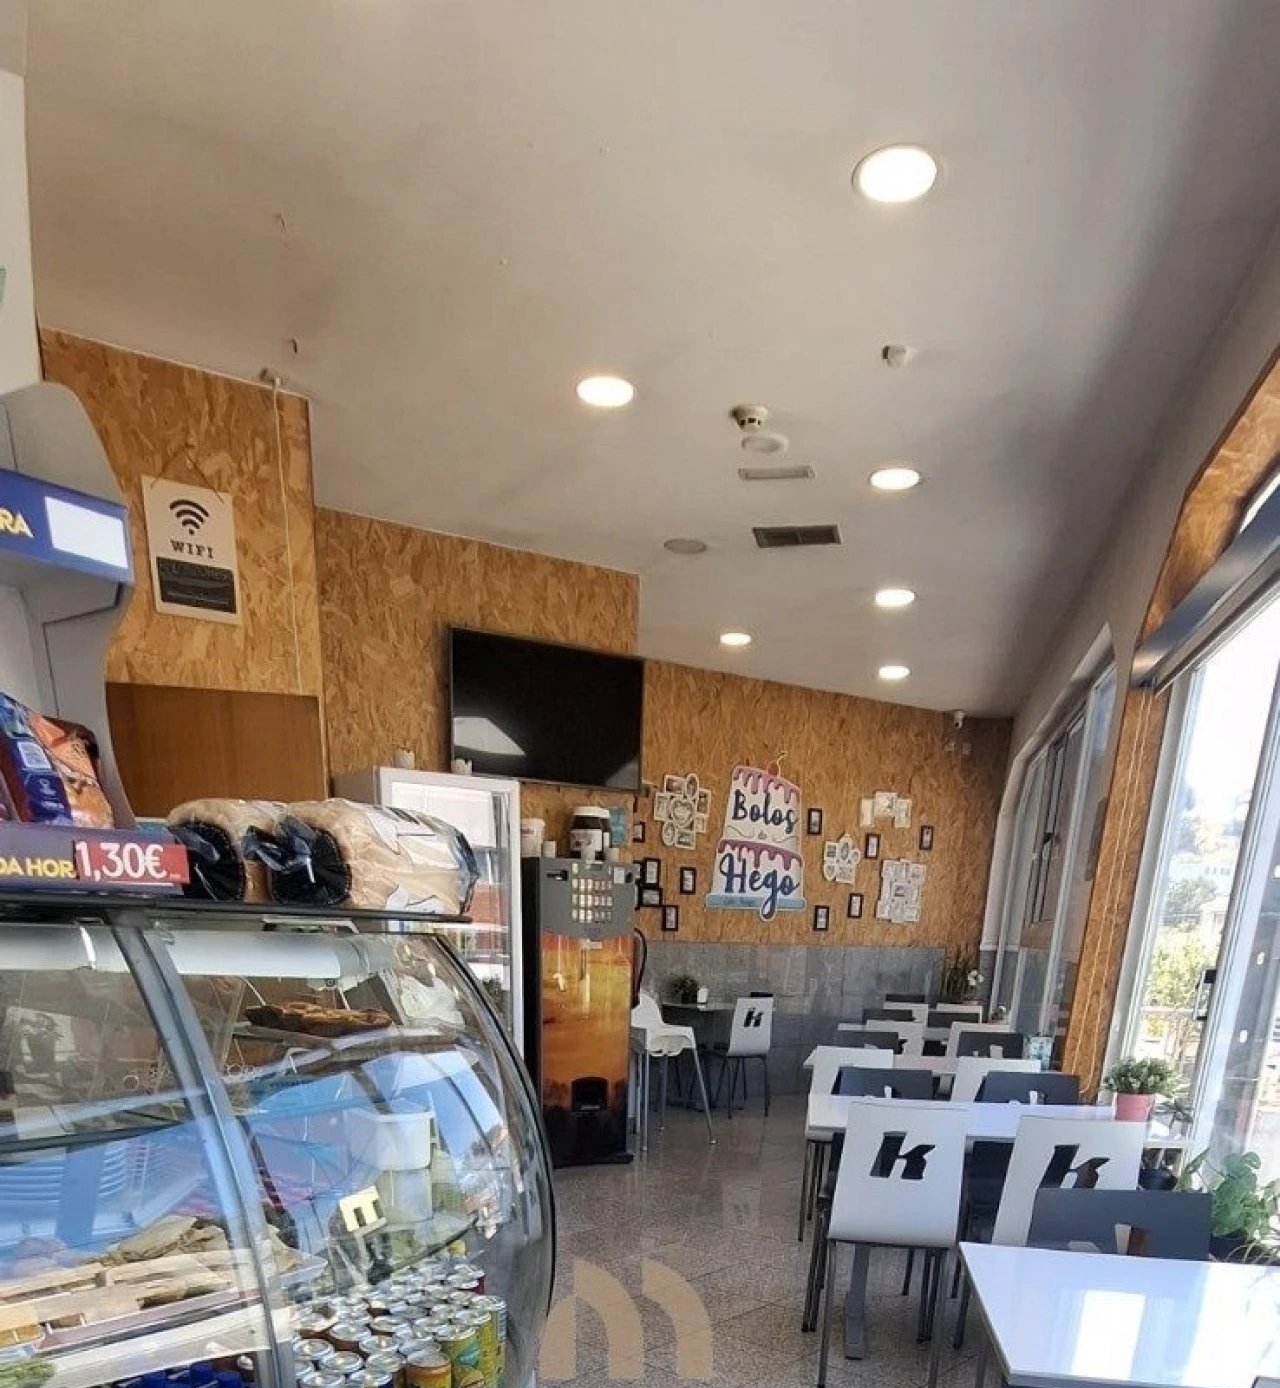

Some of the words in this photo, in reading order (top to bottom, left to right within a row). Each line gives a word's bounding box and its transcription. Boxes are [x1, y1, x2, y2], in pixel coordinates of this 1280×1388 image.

[169, 539, 214, 559] WIFI
[732, 788, 799, 834] Bolos
[26, 857, 77, 879] HOR
[75, 840, 168, 882] 1,30€
[719, 853, 800, 919] Hego
